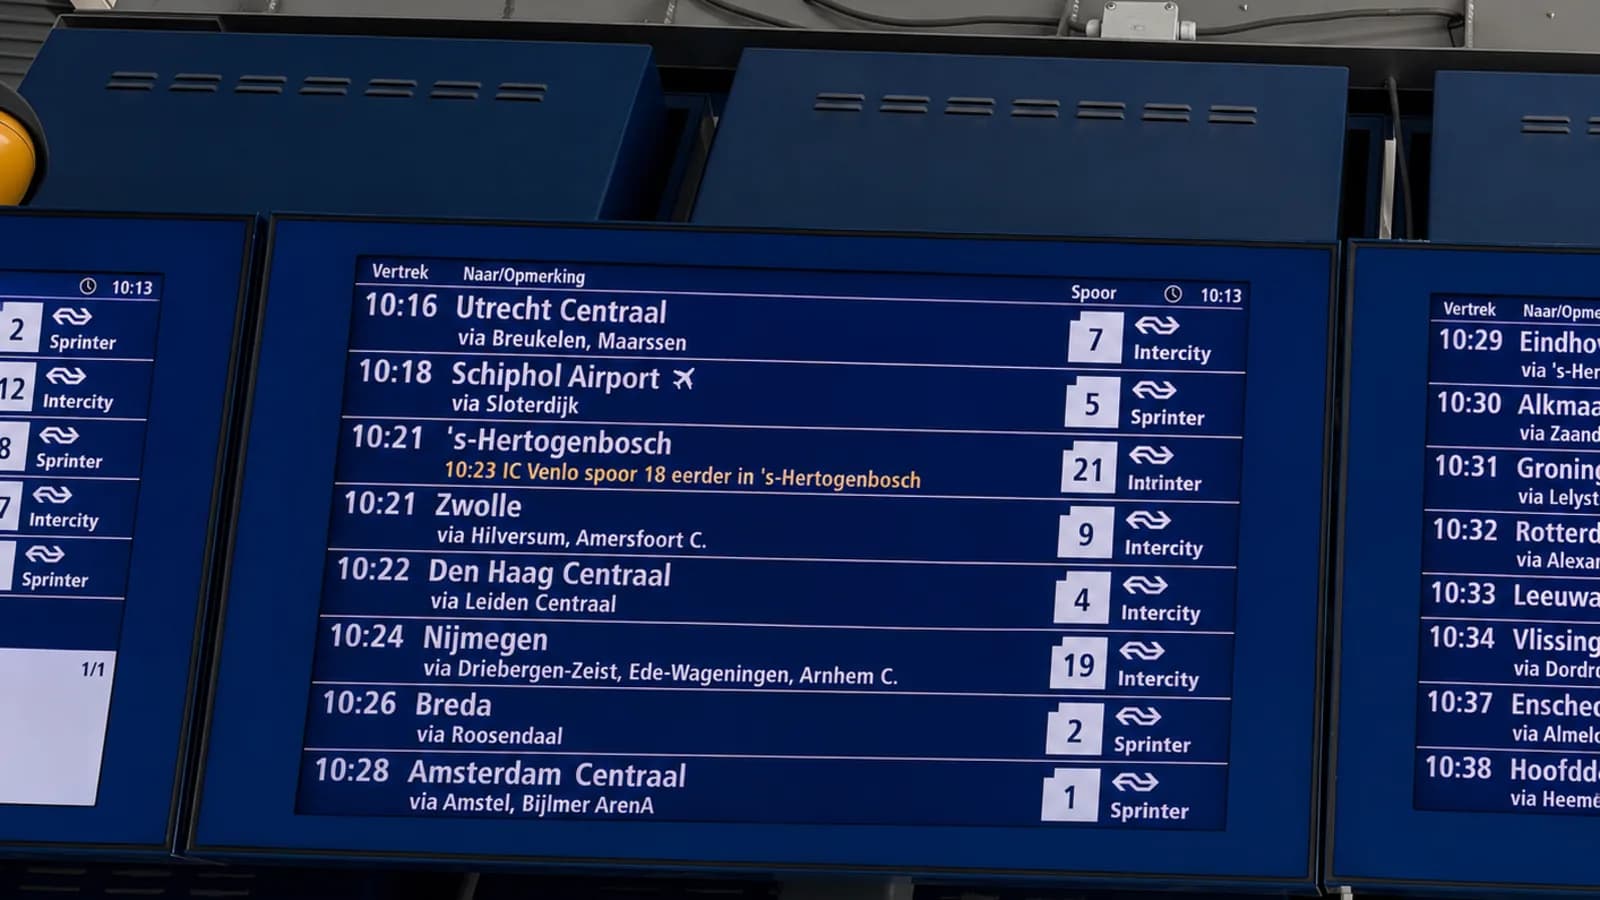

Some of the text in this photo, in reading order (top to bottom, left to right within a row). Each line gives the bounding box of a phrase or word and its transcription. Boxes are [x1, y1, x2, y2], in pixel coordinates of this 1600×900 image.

[373, 264, 428, 279] Vertrek
[464, 267, 585, 287] Naar/Opmerking
[113, 281, 152, 295] 10:13
[1072, 285, 1117, 303] Spoor
[1202, 288, 1241, 303] 10:13
[367, 292, 437, 317] 10:16
[457, 295, 666, 323] Utrecht Centraal
[1444, 302, 1496, 316] Vertrek
[10, 319, 23, 340] 2
[458, 329, 686, 351] via Breukelen, Maarssen
[1090, 329, 1102, 350] 7
[1440, 329, 1502, 350] 10:29
[50, 334, 116, 352] Sprinter
[1135, 344, 1211, 365] Intercity
[360, 359, 431, 383] 10:18
[452, 361, 660, 394] Schiphol Airport
[1522, 362, 1546, 377] via
[0, 378, 24, 399] 12
[44, 394, 113, 413] Intercity
[452, 394, 578, 418] via Sloterdijk
[1086, 393, 1099, 415] 5
[1438, 392, 1501, 413] 10:30
[1131, 409, 1205, 428] Sprinter
[353, 424, 421, 449] 10:21
[448, 426, 671, 458] 's-Hertogenbosch
[1520, 424, 1544, 440] via
[0, 437, 10, 459] 8
[37, 453, 103, 471] Sprinter
[1074, 458, 1101, 481] 21
[1436, 455, 1496, 477] 10:31
[446, 461, 920, 491] 10:23 IC Venlo spoor 18 eerder in 's-Hertogenbosch
[0, 497, 10, 518] 7
[346, 491, 414, 515] 10:21
[436, 493, 521, 517] Zwolle
[1519, 488, 1599, 509] via Lelyst
[30, 513, 99, 531] Intercity
[1434, 518, 1497, 540] 10:32
[1517, 521, 1600, 544] Rotterd
[438, 526, 706, 548] via Hilversum, Amersfoort C.
[1080, 523, 1093, 546] 9
[1126, 540, 1203, 560] Intercity
[1517, 551, 1541, 567] via
[339, 557, 409, 581] 10:22
[429, 559, 670, 590] Den Haag Centraal
[22, 572, 88, 590] Sprinter
[431, 591, 616, 612] via Leiden Centraal
[1075, 589, 1090, 611] 4
[1432, 581, 1495, 604] 10:33
[1515, 584, 1600, 607] Leeuwa
[1122, 605, 1200, 625] Intercity
[332, 624, 403, 648] 10:24
[424, 625, 547, 656] Nijmegen
[1431, 626, 1495, 648] 10:34
[1513, 628, 1600, 658] Vlissing
[83, 662, 104, 676] 1/1
[424, 659, 897, 687] via Driebergen-Zeist, Ede-Wageningen, Arnhem C.
[1065, 654, 1094, 677] 19
[1514, 660, 1539, 676] via
[1119, 671, 1199, 691] Intercity
[324, 691, 396, 714] 10:26
[416, 692, 491, 716] Breda
[1428, 691, 1492, 713] 10:37
[417, 725, 562, 744] via Roosendaal
[1068, 720, 1081, 742] 2
[1513, 725, 1538, 741] via
[1115, 736, 1191, 756] Sprinter
[317, 758, 389, 782] 10:28
[408, 760, 686, 787] Amsterdam Centraal
[1427, 756, 1491, 779] 10:38
[1511, 758, 1600, 782] Hoofdd
[410, 792, 653, 817] via Amstel, Bijlmer ArenA
[1065, 786, 1074, 808] 1
[1511, 789, 1536, 806] via
[1111, 802, 1189, 822] Sprinter
